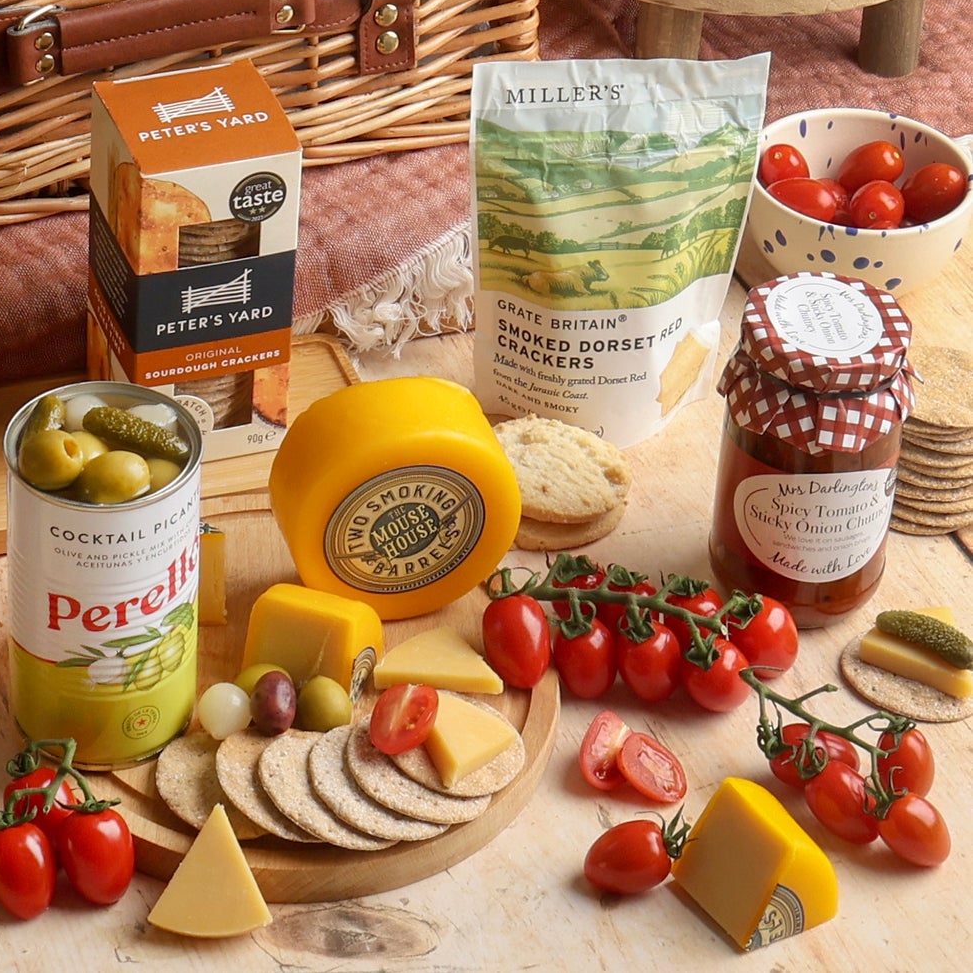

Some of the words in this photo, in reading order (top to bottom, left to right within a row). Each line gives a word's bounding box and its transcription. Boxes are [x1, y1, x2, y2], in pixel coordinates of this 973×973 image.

[506, 84, 621, 104] MILLER'S
[138, 120, 213, 143] PETER'S
[216, 111, 270, 129] YARD
[233, 189, 284, 209] taste
[244, 180, 272, 196] great
[156, 314, 223, 336] PETER'S
[229, 306, 273, 324] YARD
[497, 299, 542, 325] GRATE
[797, 303, 815, 333] Chutney
[498, 319, 570, 352] SMOKED
[580, 335, 656, 353] DORSET
[659, 317, 683, 341] RED
[819, 321, 835, 344] Onion
[830, 313, 848, 341] Tomato
[145, 361, 217, 380] SOURDOUGH
[221, 349, 281, 367] CRACKERS
[185, 346, 242, 362] ORIGINAL
[497, 334, 594, 369] CRACKERS
[493, 353, 518, 369] Made
[519, 361, 537, 377] with
[537, 371, 567, 387] freshly
[568, 374, 595, 387] grated
[598, 376, 627, 386] Dorset
[630, 371, 647, 382] Red
[514, 377, 528, 388] the
[528, 382, 561, 398] Jurassic
[562, 390, 589, 400] Coast.
[521, 394, 541, 405] AND
[544, 402, 580, 414] SMOKY
[778, 483, 805, 497] Mrs
[348, 515, 369, 552] TWO
[367, 484, 456, 512] SMOKING
[388, 505, 406, 519] THE
[750, 504, 792, 534] Sticky
[796, 518, 842, 534] Onion
[771, 497, 811, 518] Spicy
[815, 500, 868, 518] Tomato
[870, 493, 879, 507] &
[50, 526, 146, 545] COCKTAIL
[371, 504, 429, 546] MOUSE
[383, 518, 438, 559] HOUSE
[54, 547, 83, 559] OLIVE
[113, 549, 146, 561] PICKLE
[150, 541, 165, 551] MIX
[373, 527, 461, 577] BARRELS
[768, 551, 809, 573] Made
[811, 559, 843, 575] with
[847, 547, 872, 568] Love
[76, 561, 133, 569] ACEITUNAS
